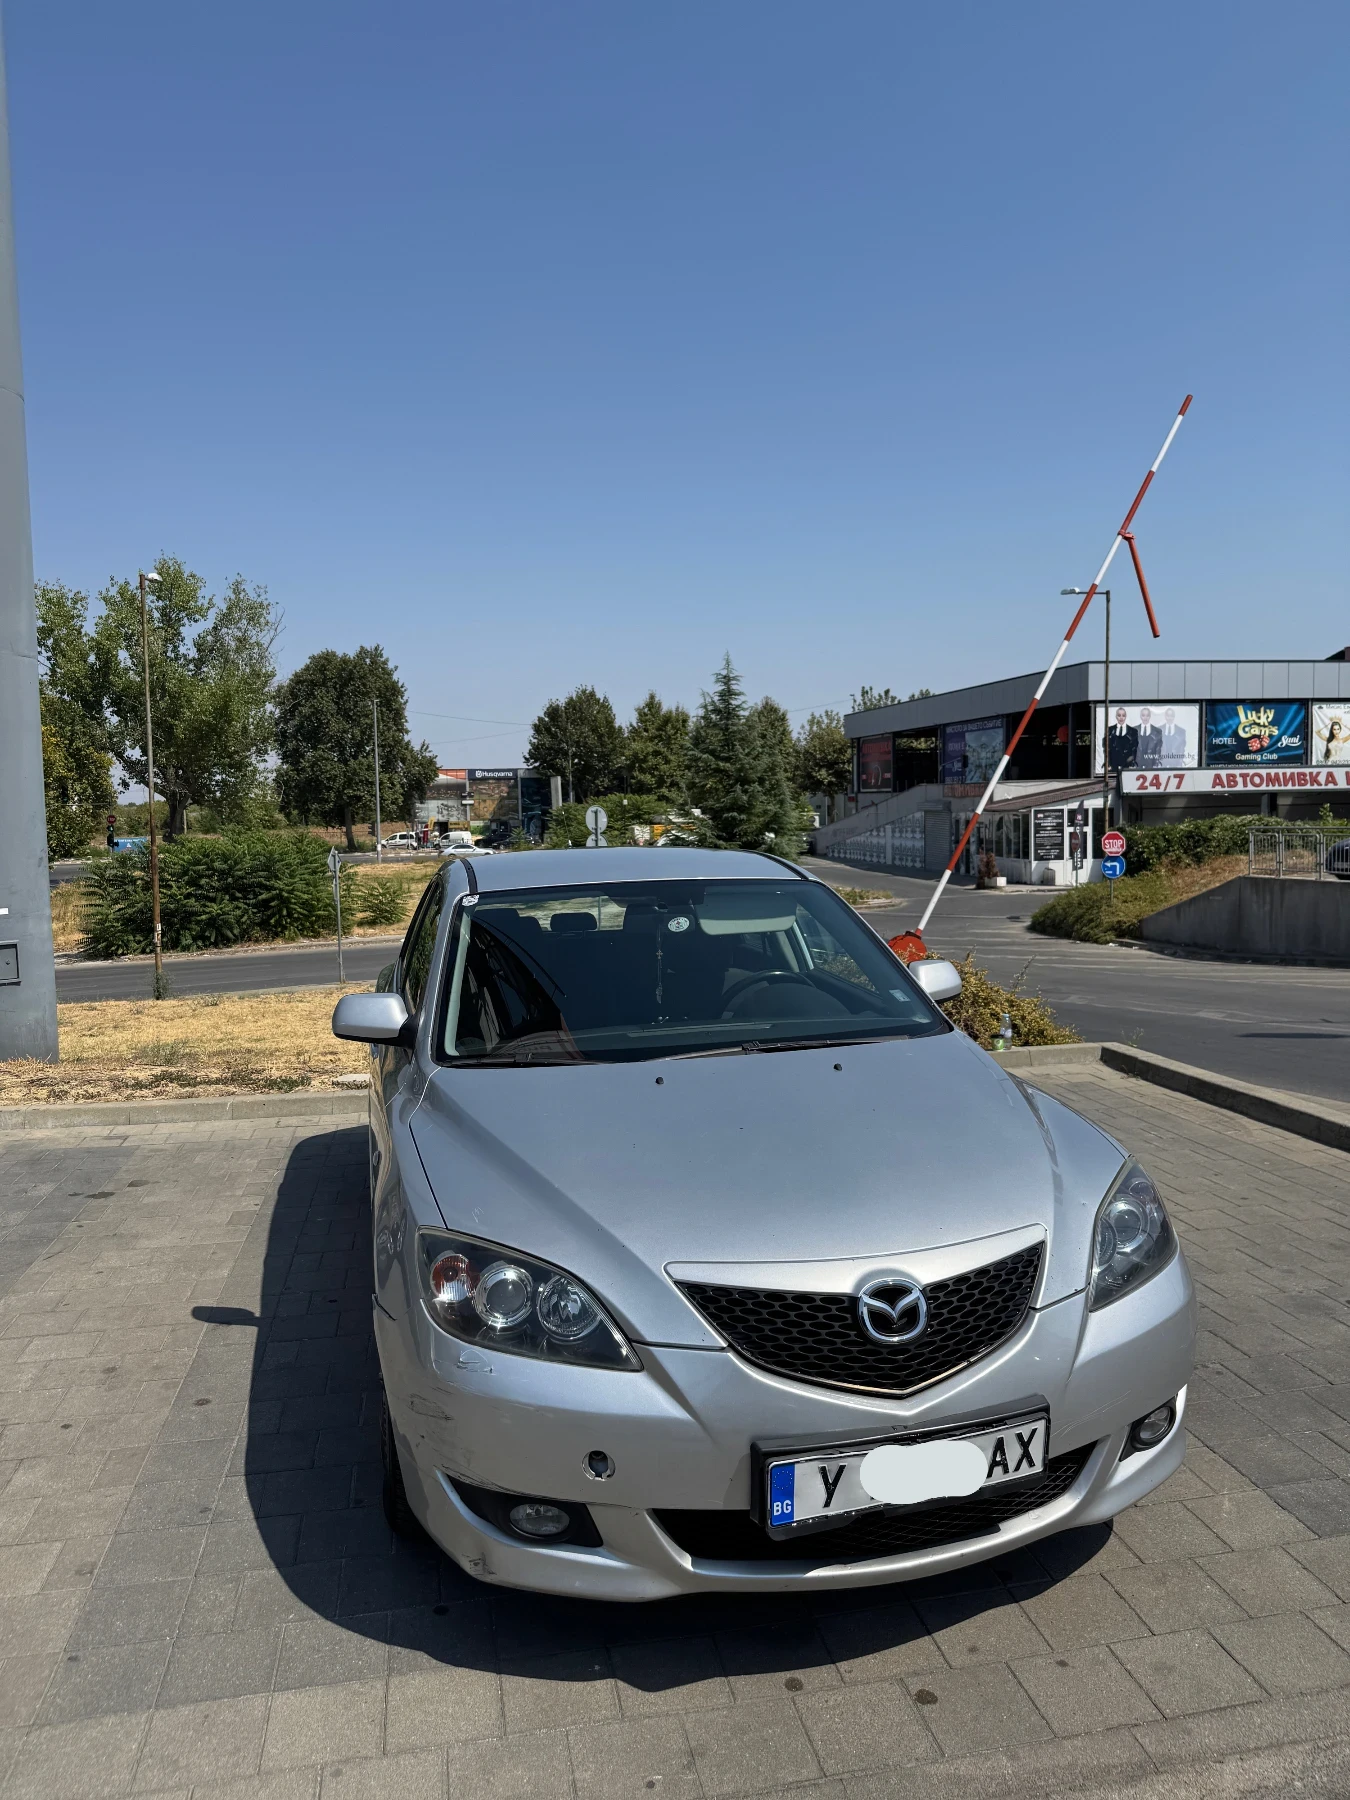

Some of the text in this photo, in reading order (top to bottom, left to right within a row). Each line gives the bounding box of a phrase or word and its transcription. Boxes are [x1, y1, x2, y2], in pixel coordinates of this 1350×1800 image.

[1237, 705, 1275, 726] Lucky
[1238, 720, 1278, 738] Games
[1212, 737, 1237, 745] HOTEL
[1235, 752, 1278, 761] Gaming Club
[1135, 773, 1186, 791] 24/7
[1211, 771, 1338, 788] АВТОМИВКА
[1104, 839, 1123, 849] STOP
[986, 1427, 1039, 1479] AX
[773, 1499, 792, 1516] BG
